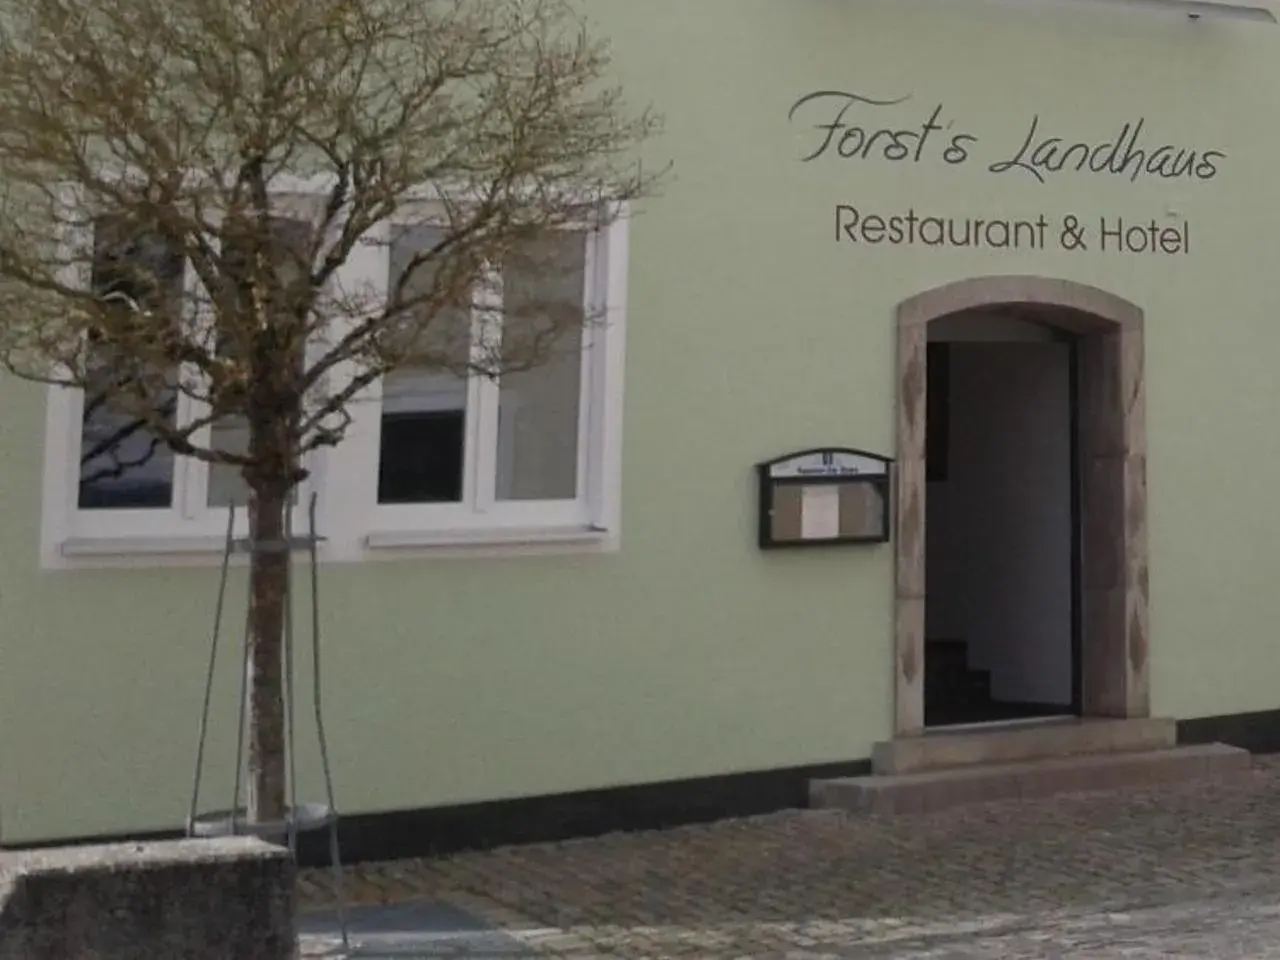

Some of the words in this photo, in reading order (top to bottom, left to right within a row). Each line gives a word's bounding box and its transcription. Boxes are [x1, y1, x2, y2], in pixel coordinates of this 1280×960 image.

[788, 91, 978, 163] Forst's
[988, 115, 1227, 184] Landhaus
[835, 204, 1049, 250] Restaurant
[1059, 214, 1088, 251] &
[1100, 215, 1189, 255] Hotel
